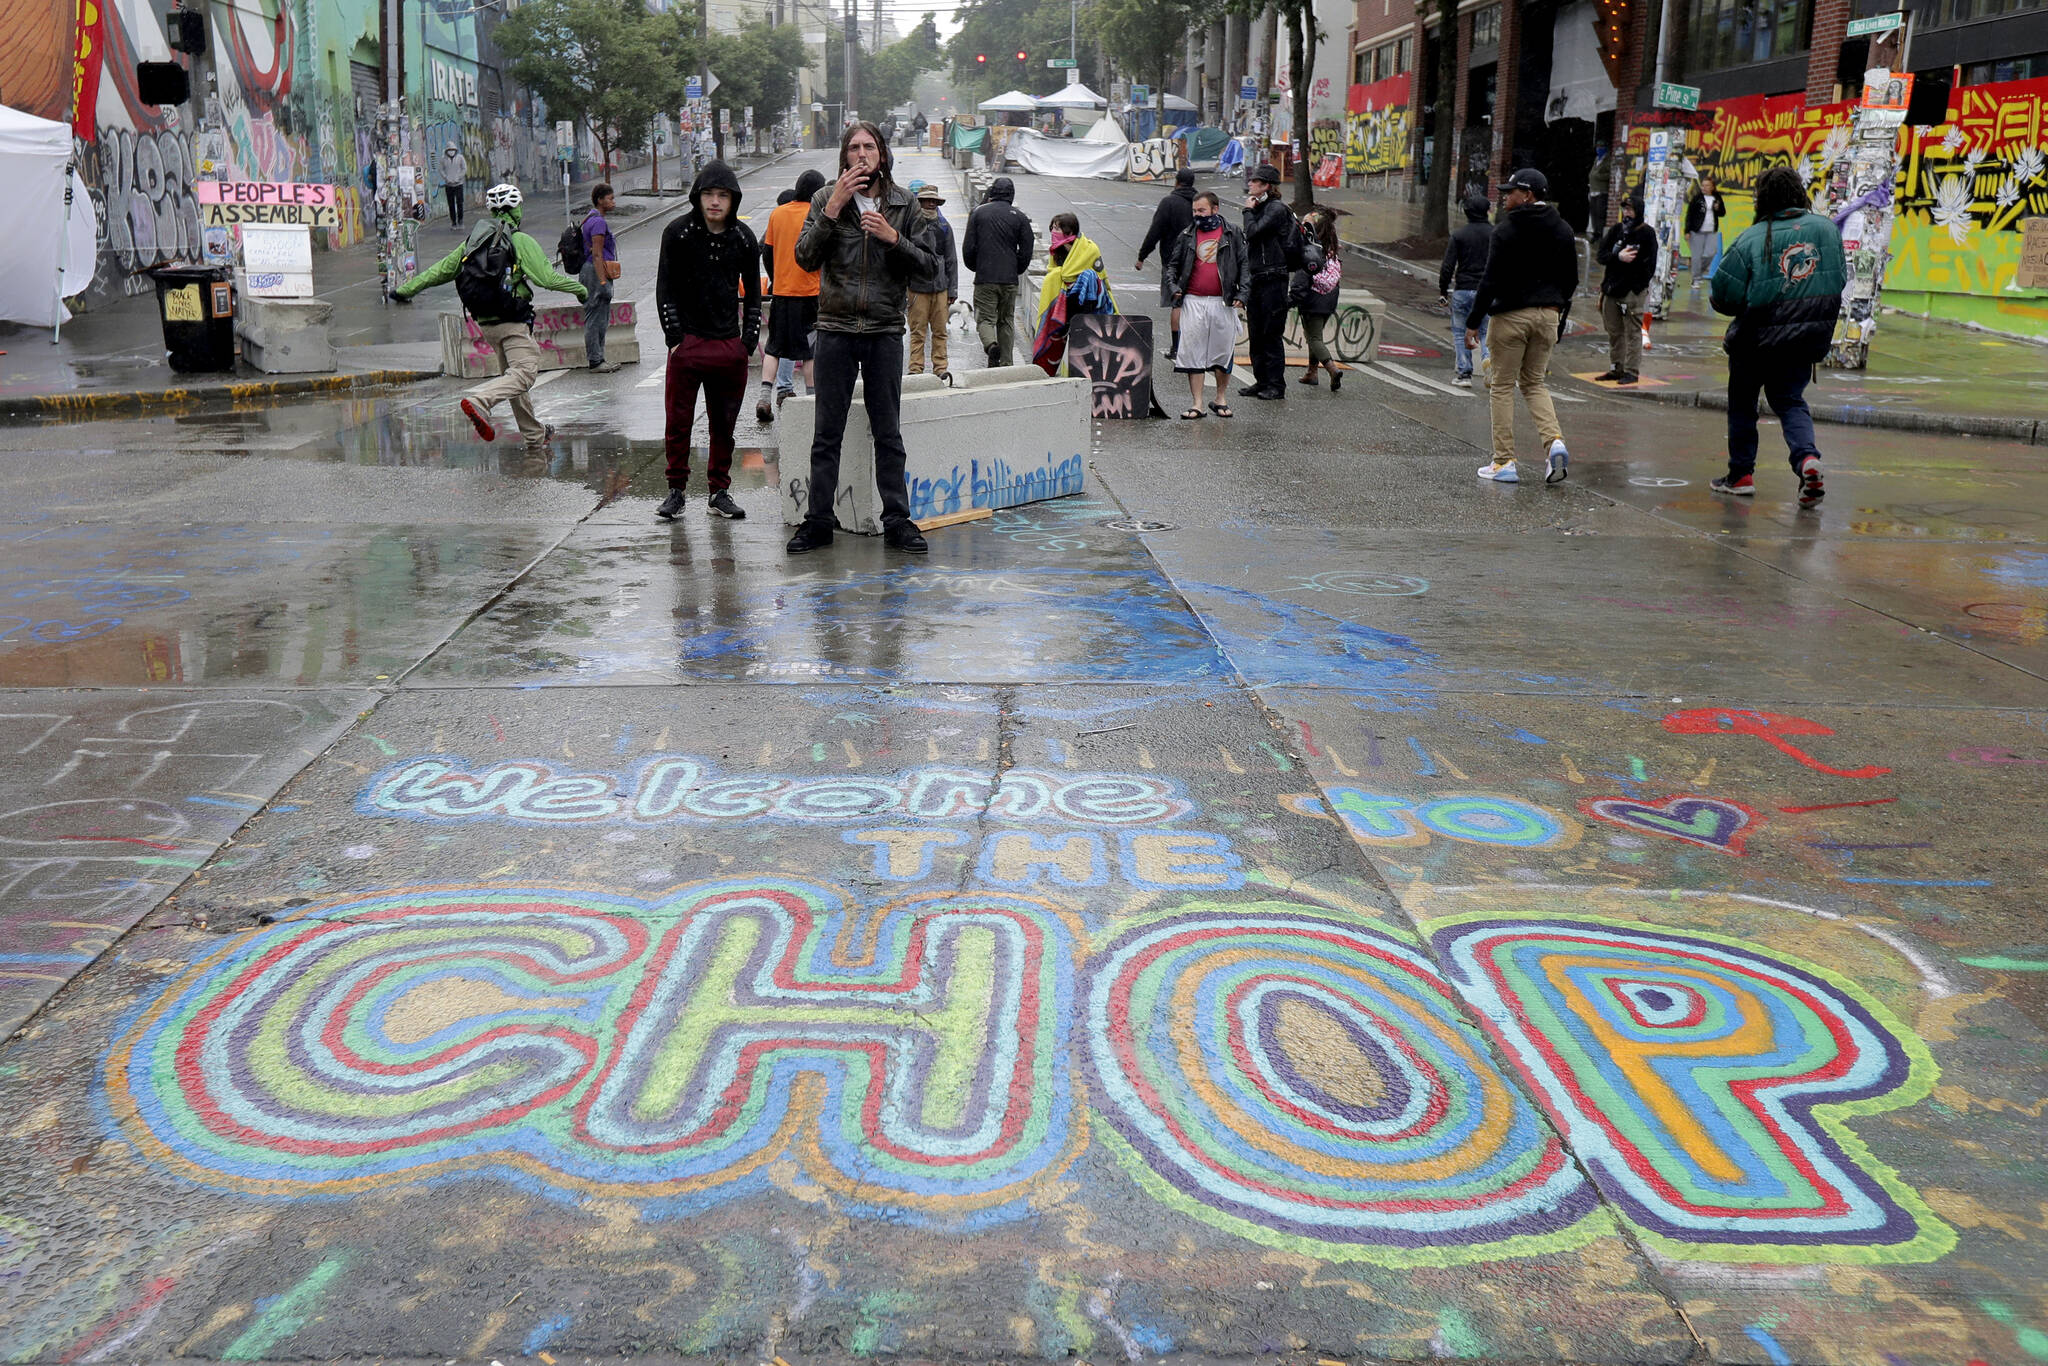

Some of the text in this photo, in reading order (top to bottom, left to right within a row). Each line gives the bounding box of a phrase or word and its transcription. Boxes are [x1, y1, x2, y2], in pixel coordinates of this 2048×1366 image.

[1660, 88, 1666, 101] E
[1666, 86, 1682, 104] Pine
[1682, 93, 1690, 105] St
[1312, 127, 1337, 144] NO
[218, 182, 326, 205] PEOPLE'S
[210, 204, 336, 226] ASSEMBLY:
[171, 291, 192, 300] BLACK
[173, 300, 192, 308] LIVES
[904, 465, 966, 521] uck
[360, 752, 1583, 851] Welcome to
[840, 827, 1246, 891] THE
[98, 876, 1960, 1271] CHOP
